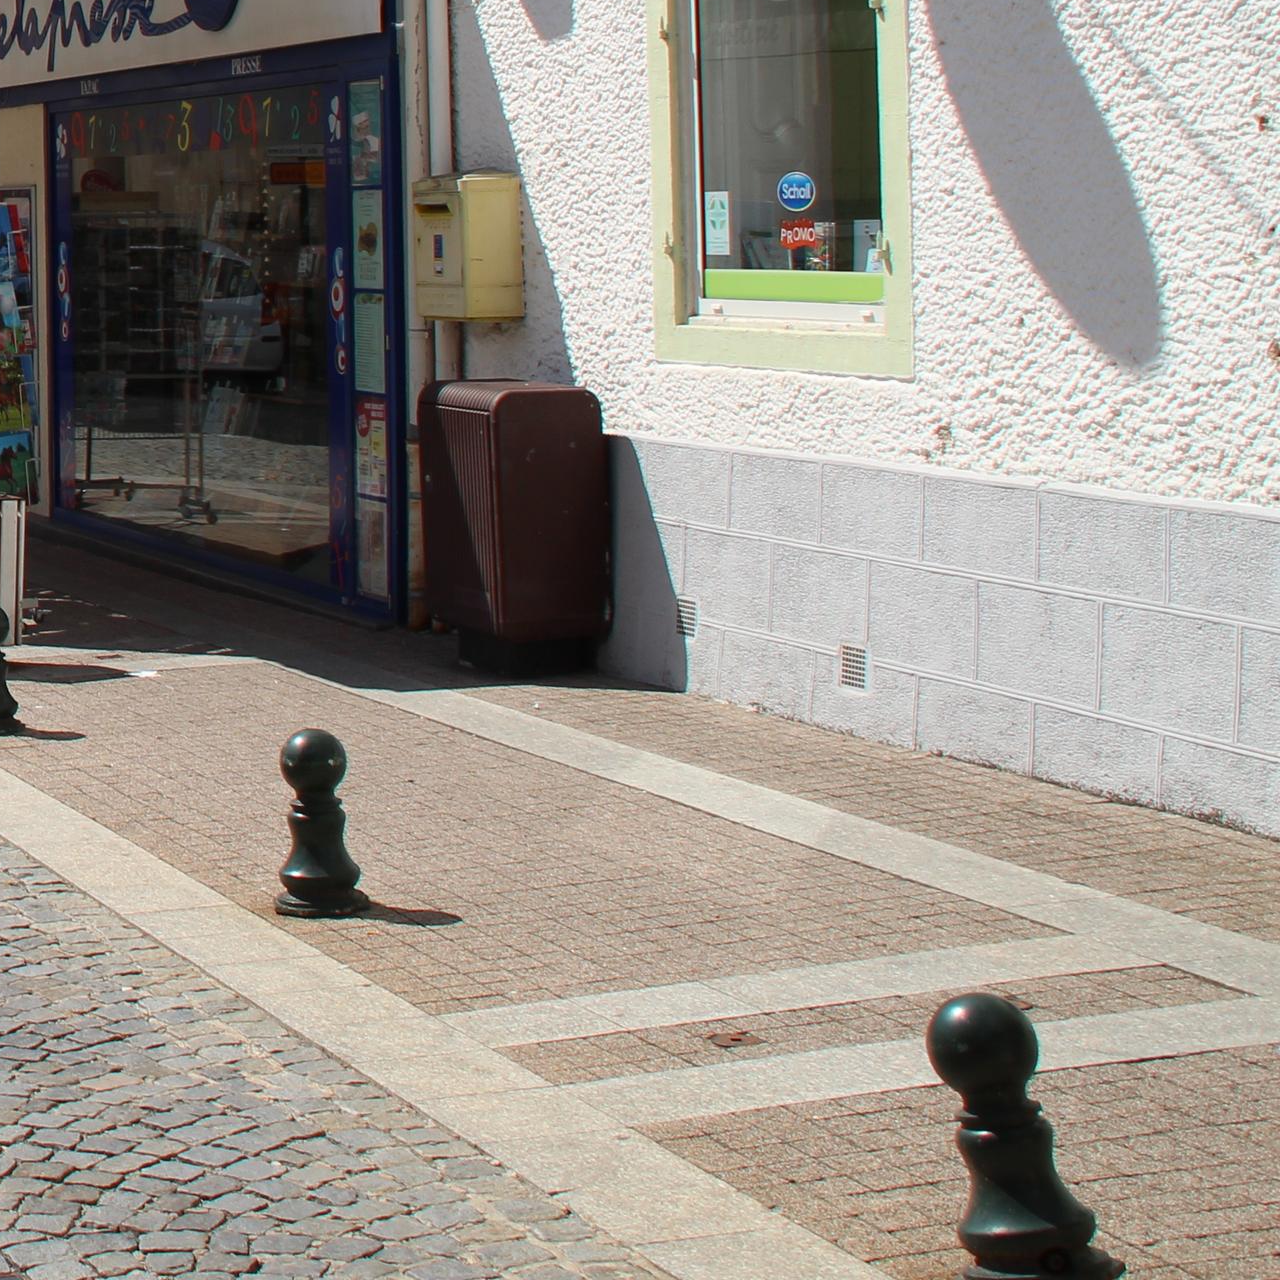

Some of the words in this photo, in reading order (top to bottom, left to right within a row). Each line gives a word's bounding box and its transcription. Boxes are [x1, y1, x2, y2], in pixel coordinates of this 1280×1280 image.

[231, 55, 262, 75] PRESSE
[782, 182, 812, 200] Scholl
[780, 227, 816, 244] PROMO
